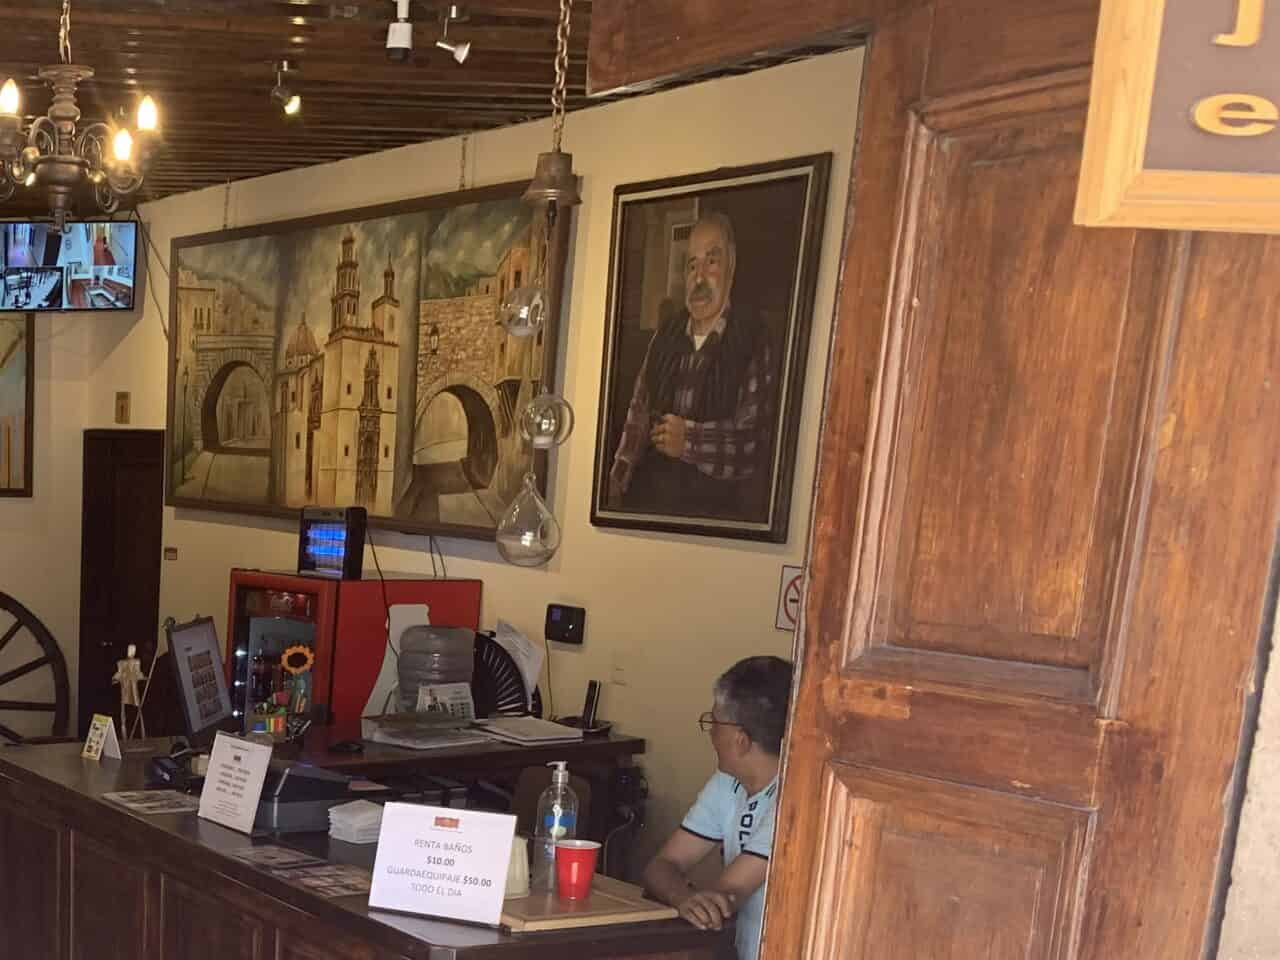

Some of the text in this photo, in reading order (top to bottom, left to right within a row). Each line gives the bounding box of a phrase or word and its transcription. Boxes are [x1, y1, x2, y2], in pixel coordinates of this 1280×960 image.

[739, 800, 758, 853] POL
[414, 839, 473, 854] RENTA BAÑOS
[426, 856, 455, 867] $10.00
[463, 875, 492, 888] $50.00
[410, 883, 434, 894] TODO
